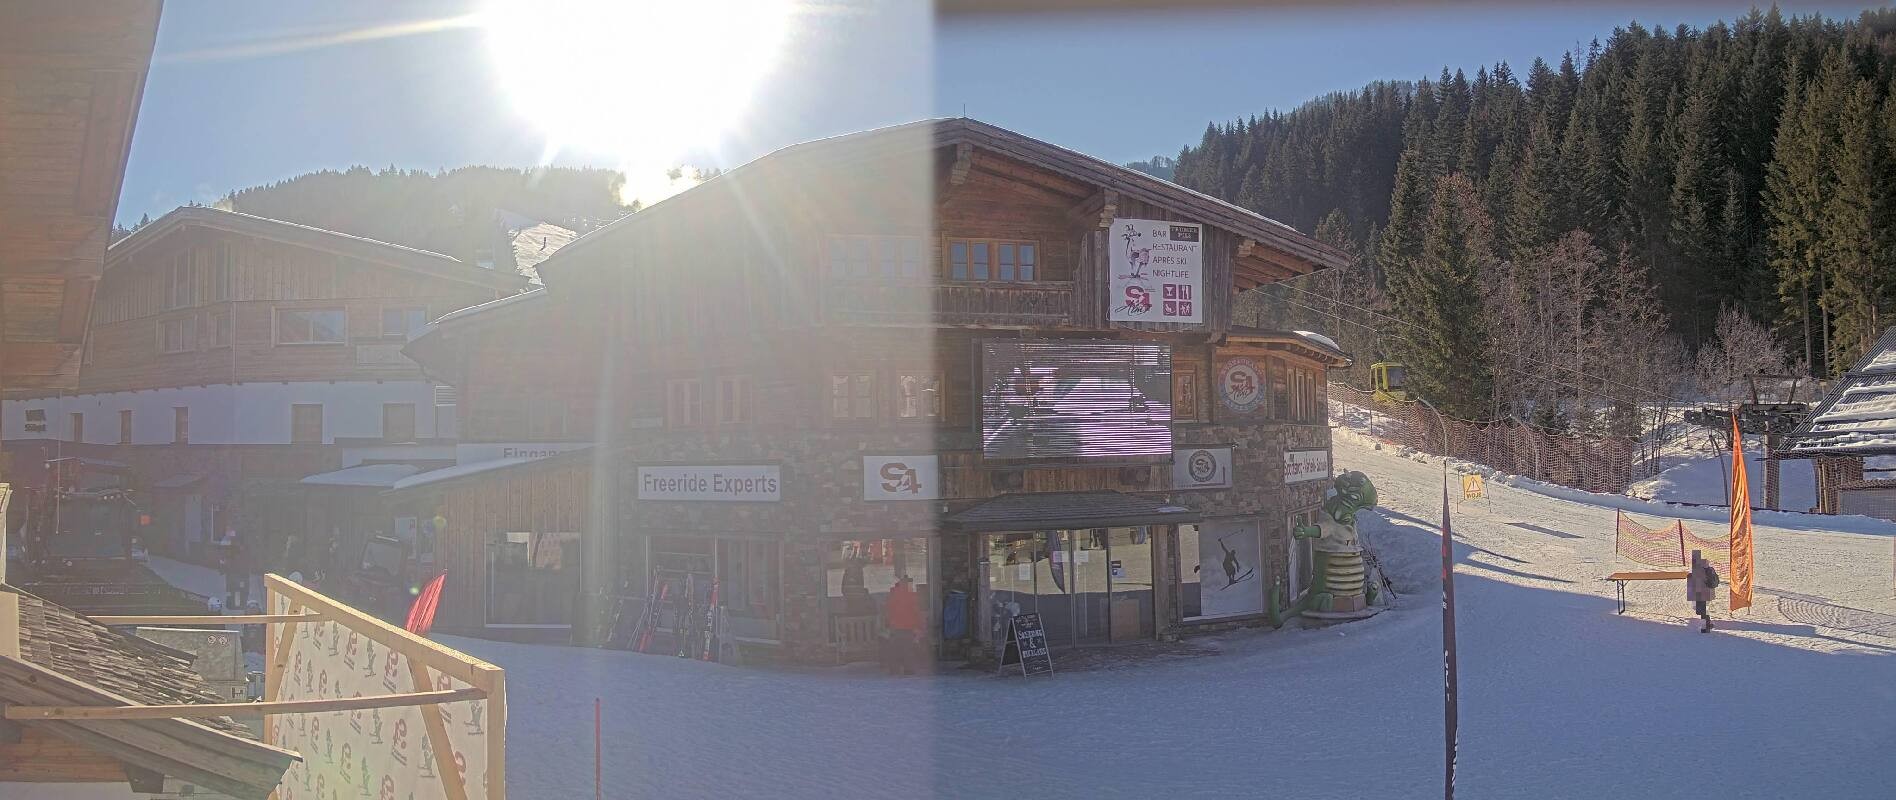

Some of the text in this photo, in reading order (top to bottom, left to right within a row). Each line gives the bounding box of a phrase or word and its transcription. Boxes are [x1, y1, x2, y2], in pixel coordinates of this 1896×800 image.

[1152, 229, 1167, 238] BAR
[1152, 243, 1198, 253] RESTAURANT
[1176, 257, 1187, 265] SKI
[1152, 269, 1190, 279] NIGHTLIFE
[503, 447, 560, 459] Eingan
[643, 473, 777, 496] Freeride Experts
